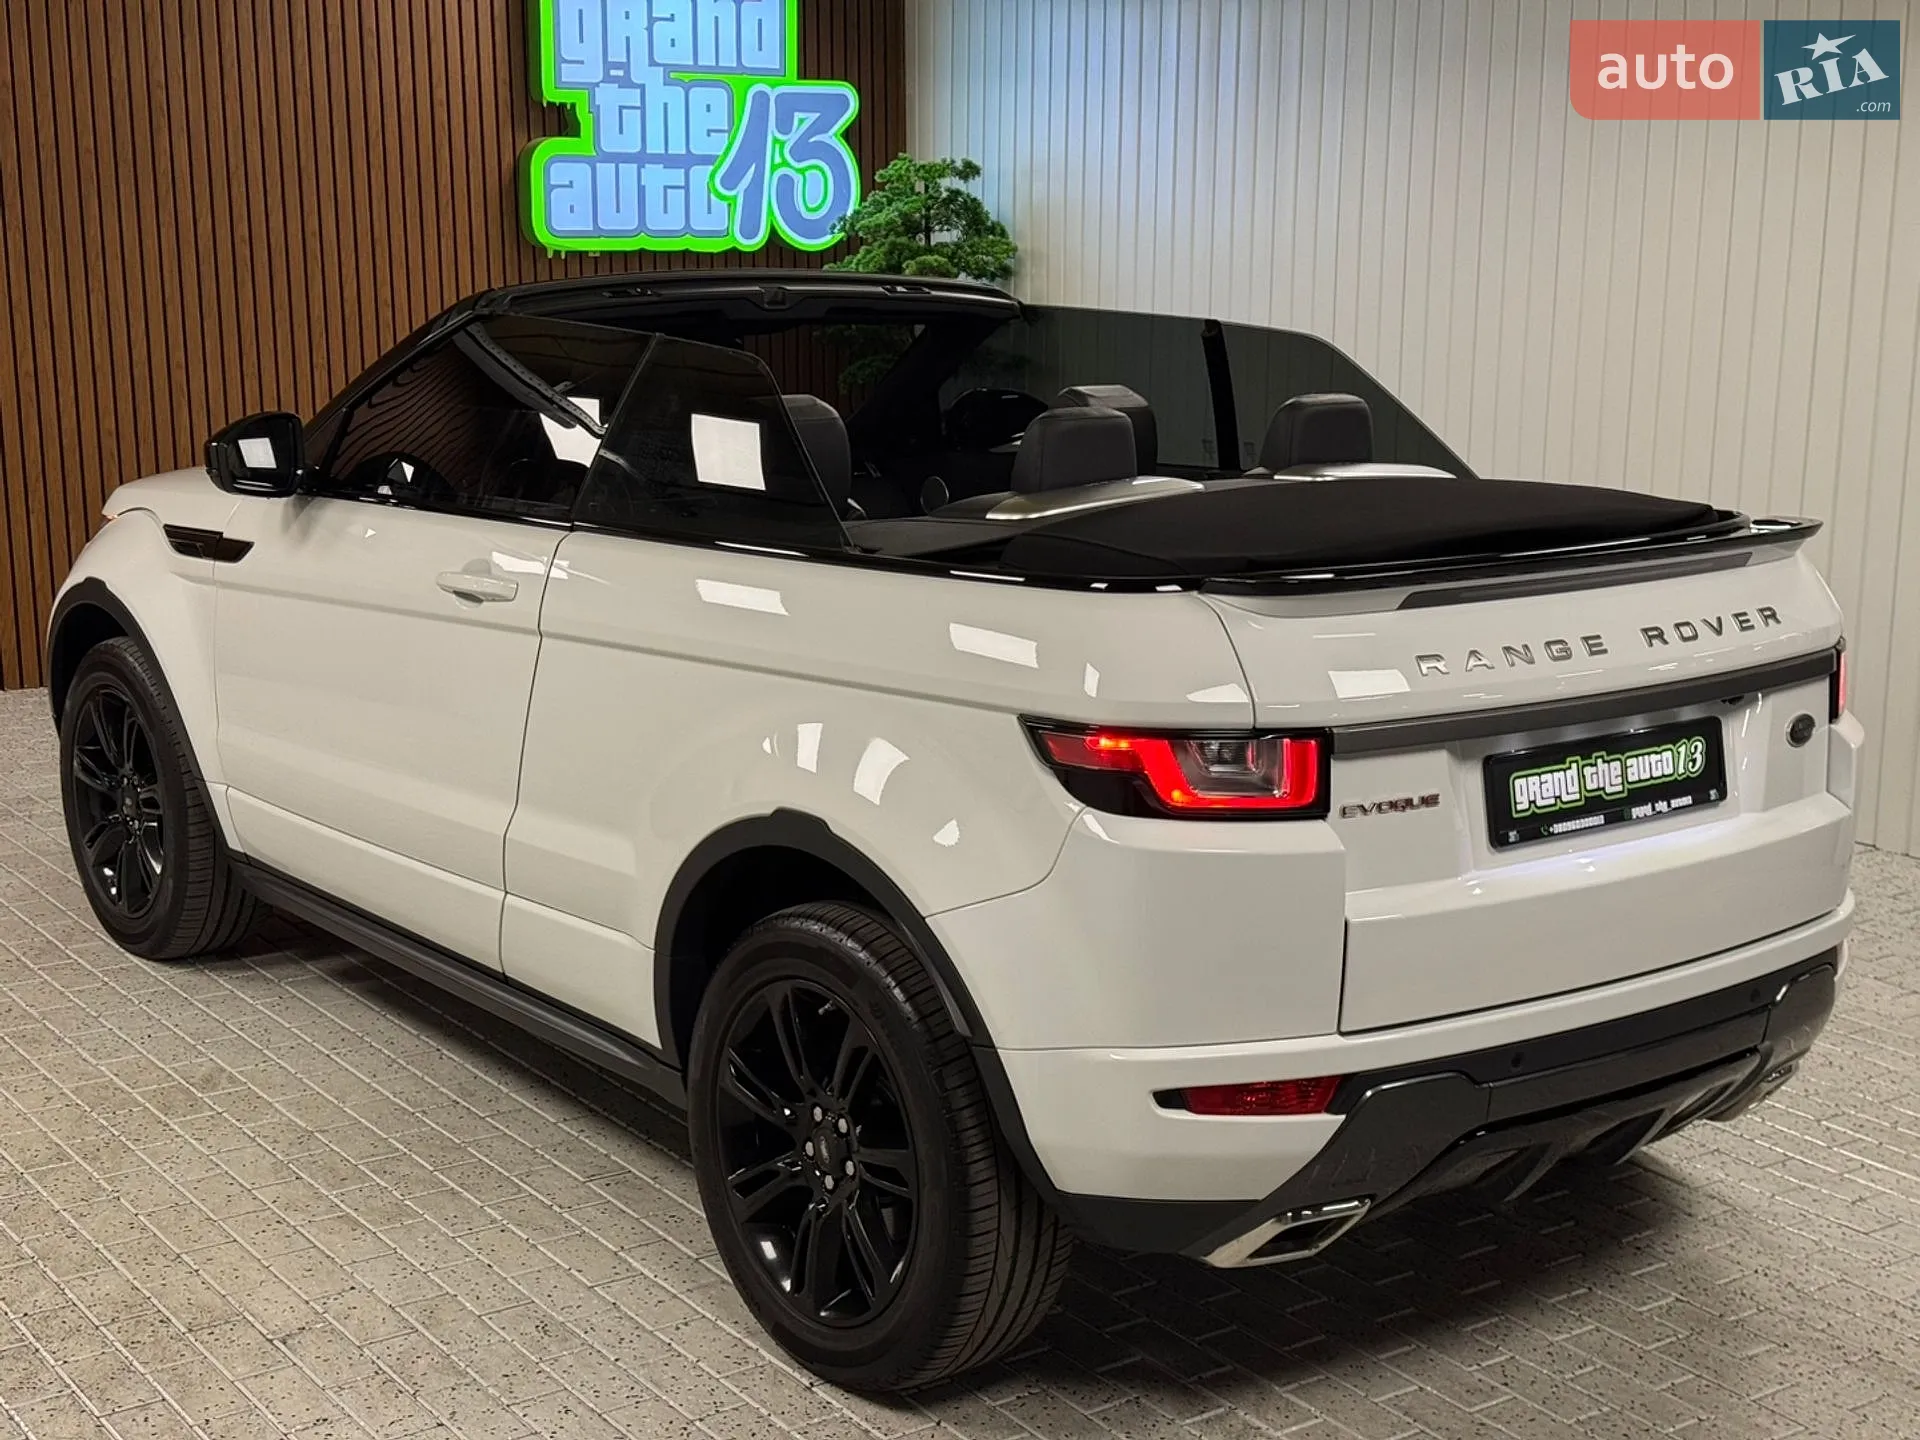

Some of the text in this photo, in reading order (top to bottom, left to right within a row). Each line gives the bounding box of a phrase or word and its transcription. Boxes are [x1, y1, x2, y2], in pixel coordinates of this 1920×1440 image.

[595, 68, 730, 155] the
[549, 162, 729, 231] auto
[1415, 606, 1782, 677] RANGE ROVER
[1341, 793, 1440, 819] EVOQUE
